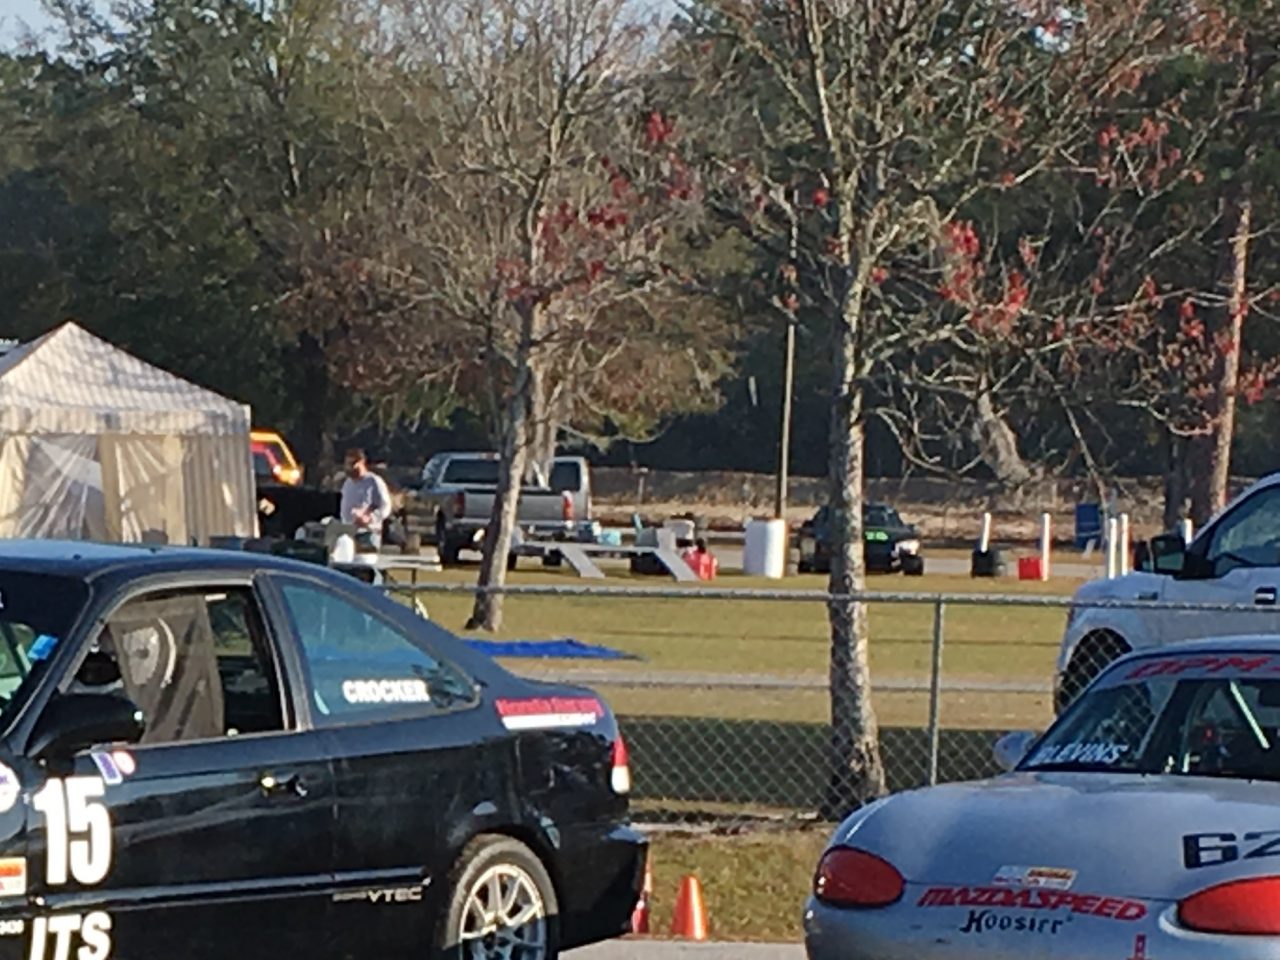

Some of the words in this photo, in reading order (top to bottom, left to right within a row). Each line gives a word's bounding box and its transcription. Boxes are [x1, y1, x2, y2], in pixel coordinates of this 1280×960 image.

[342, 679, 431, 703] CROCKER
[33, 776, 112, 885] 15
[1182, 830, 1280, 870] 62
[367, 886, 422, 902] VTEC
[916, 887, 1147, 921] MAZDASPEED
